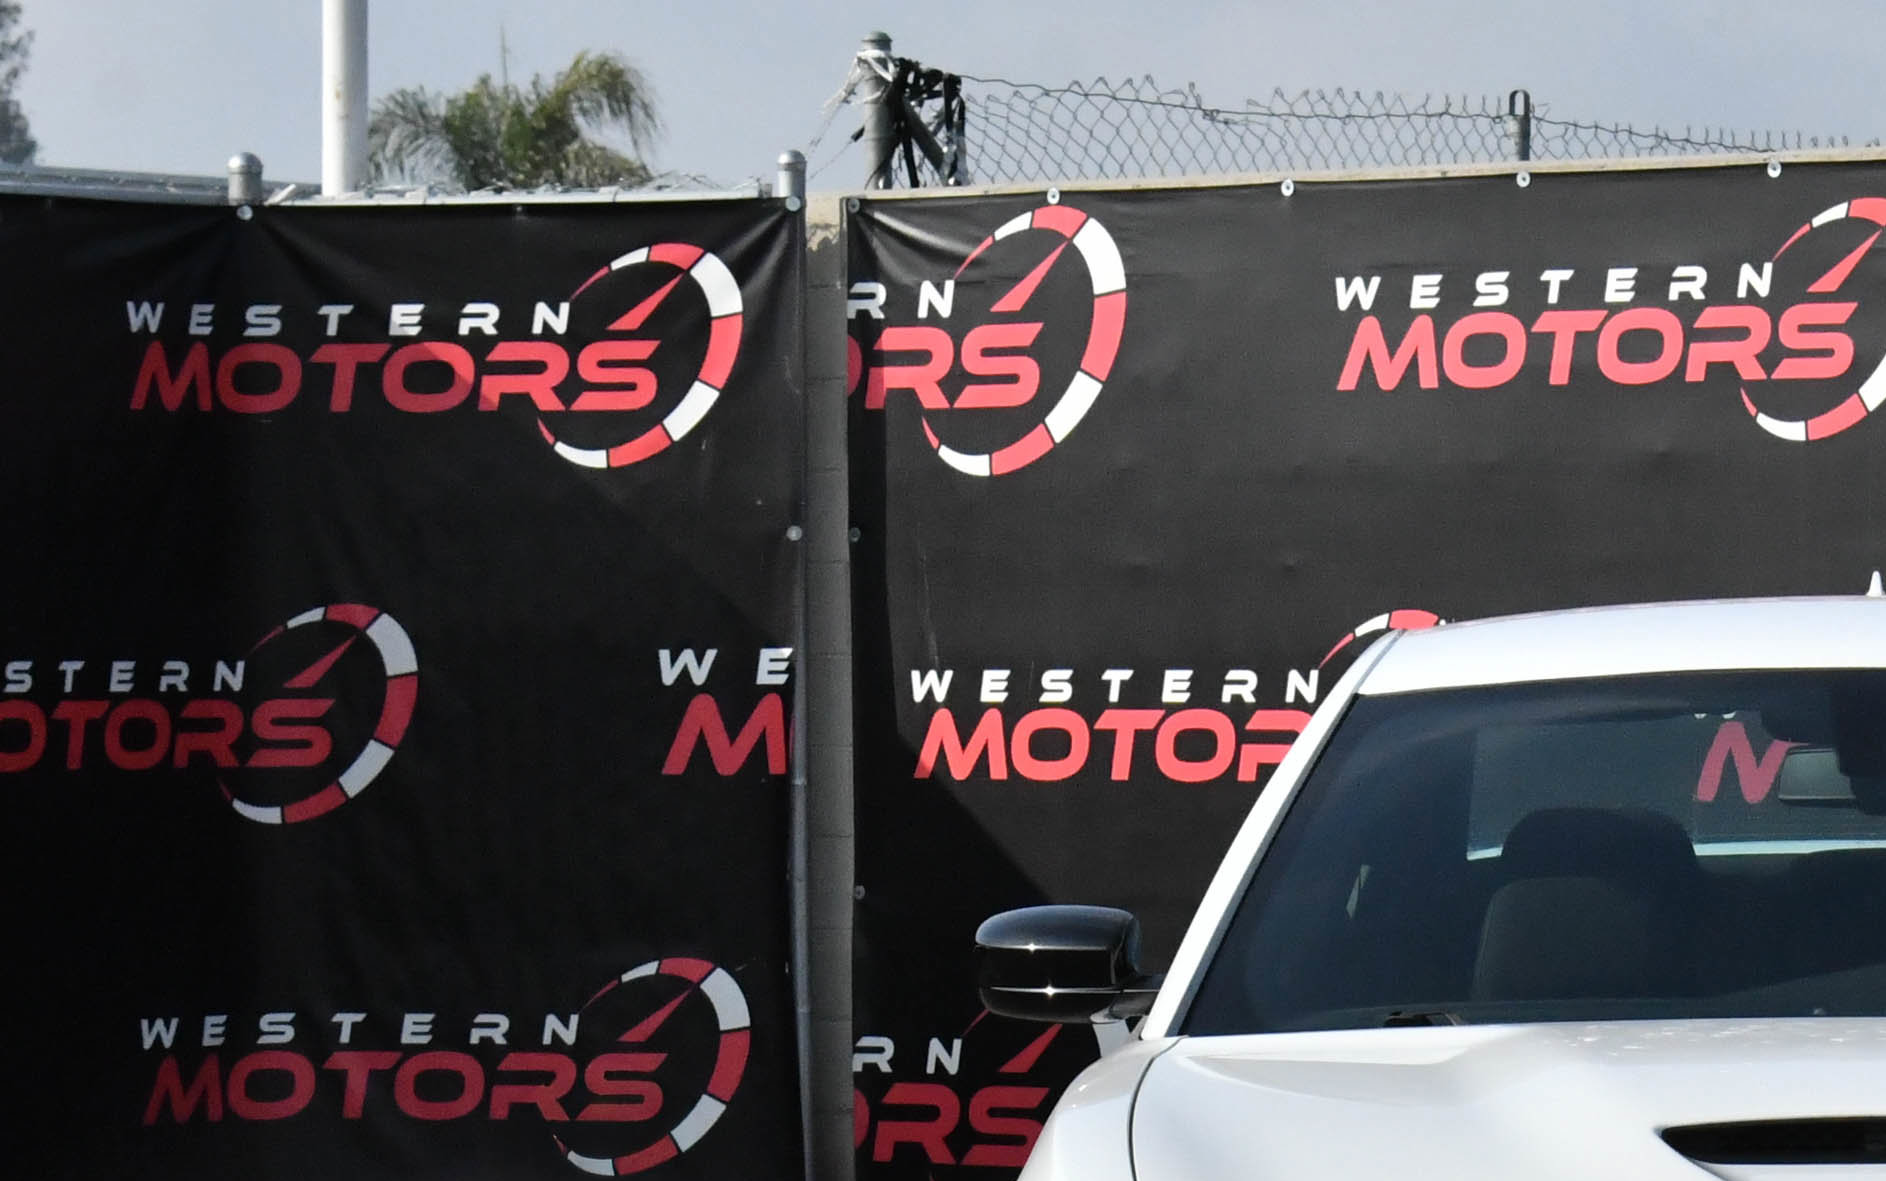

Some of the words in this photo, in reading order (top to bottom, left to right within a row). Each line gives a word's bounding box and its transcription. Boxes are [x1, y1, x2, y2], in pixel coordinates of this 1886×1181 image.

[848, 279, 955, 319] RN
[1335, 262, 1773, 307] WESTERN
[128, 302, 569, 335] WESTERN
[848, 322, 1043, 410] RS
[1338, 302, 1858, 392] MOTORS
[130, 340, 661, 413] MOTORS
[7, 662, 243, 691] STERN
[659, 648, 793, 686] WE
[911, 669, 1319, 703] WESTERN
[662, 693, 787, 776] M
[141, 1013, 579, 1049] WESTERN
[853, 1037, 961, 1074] RN
[144, 1050, 667, 1126] MOTORS
[855, 1083, 1048, 1166] RS
